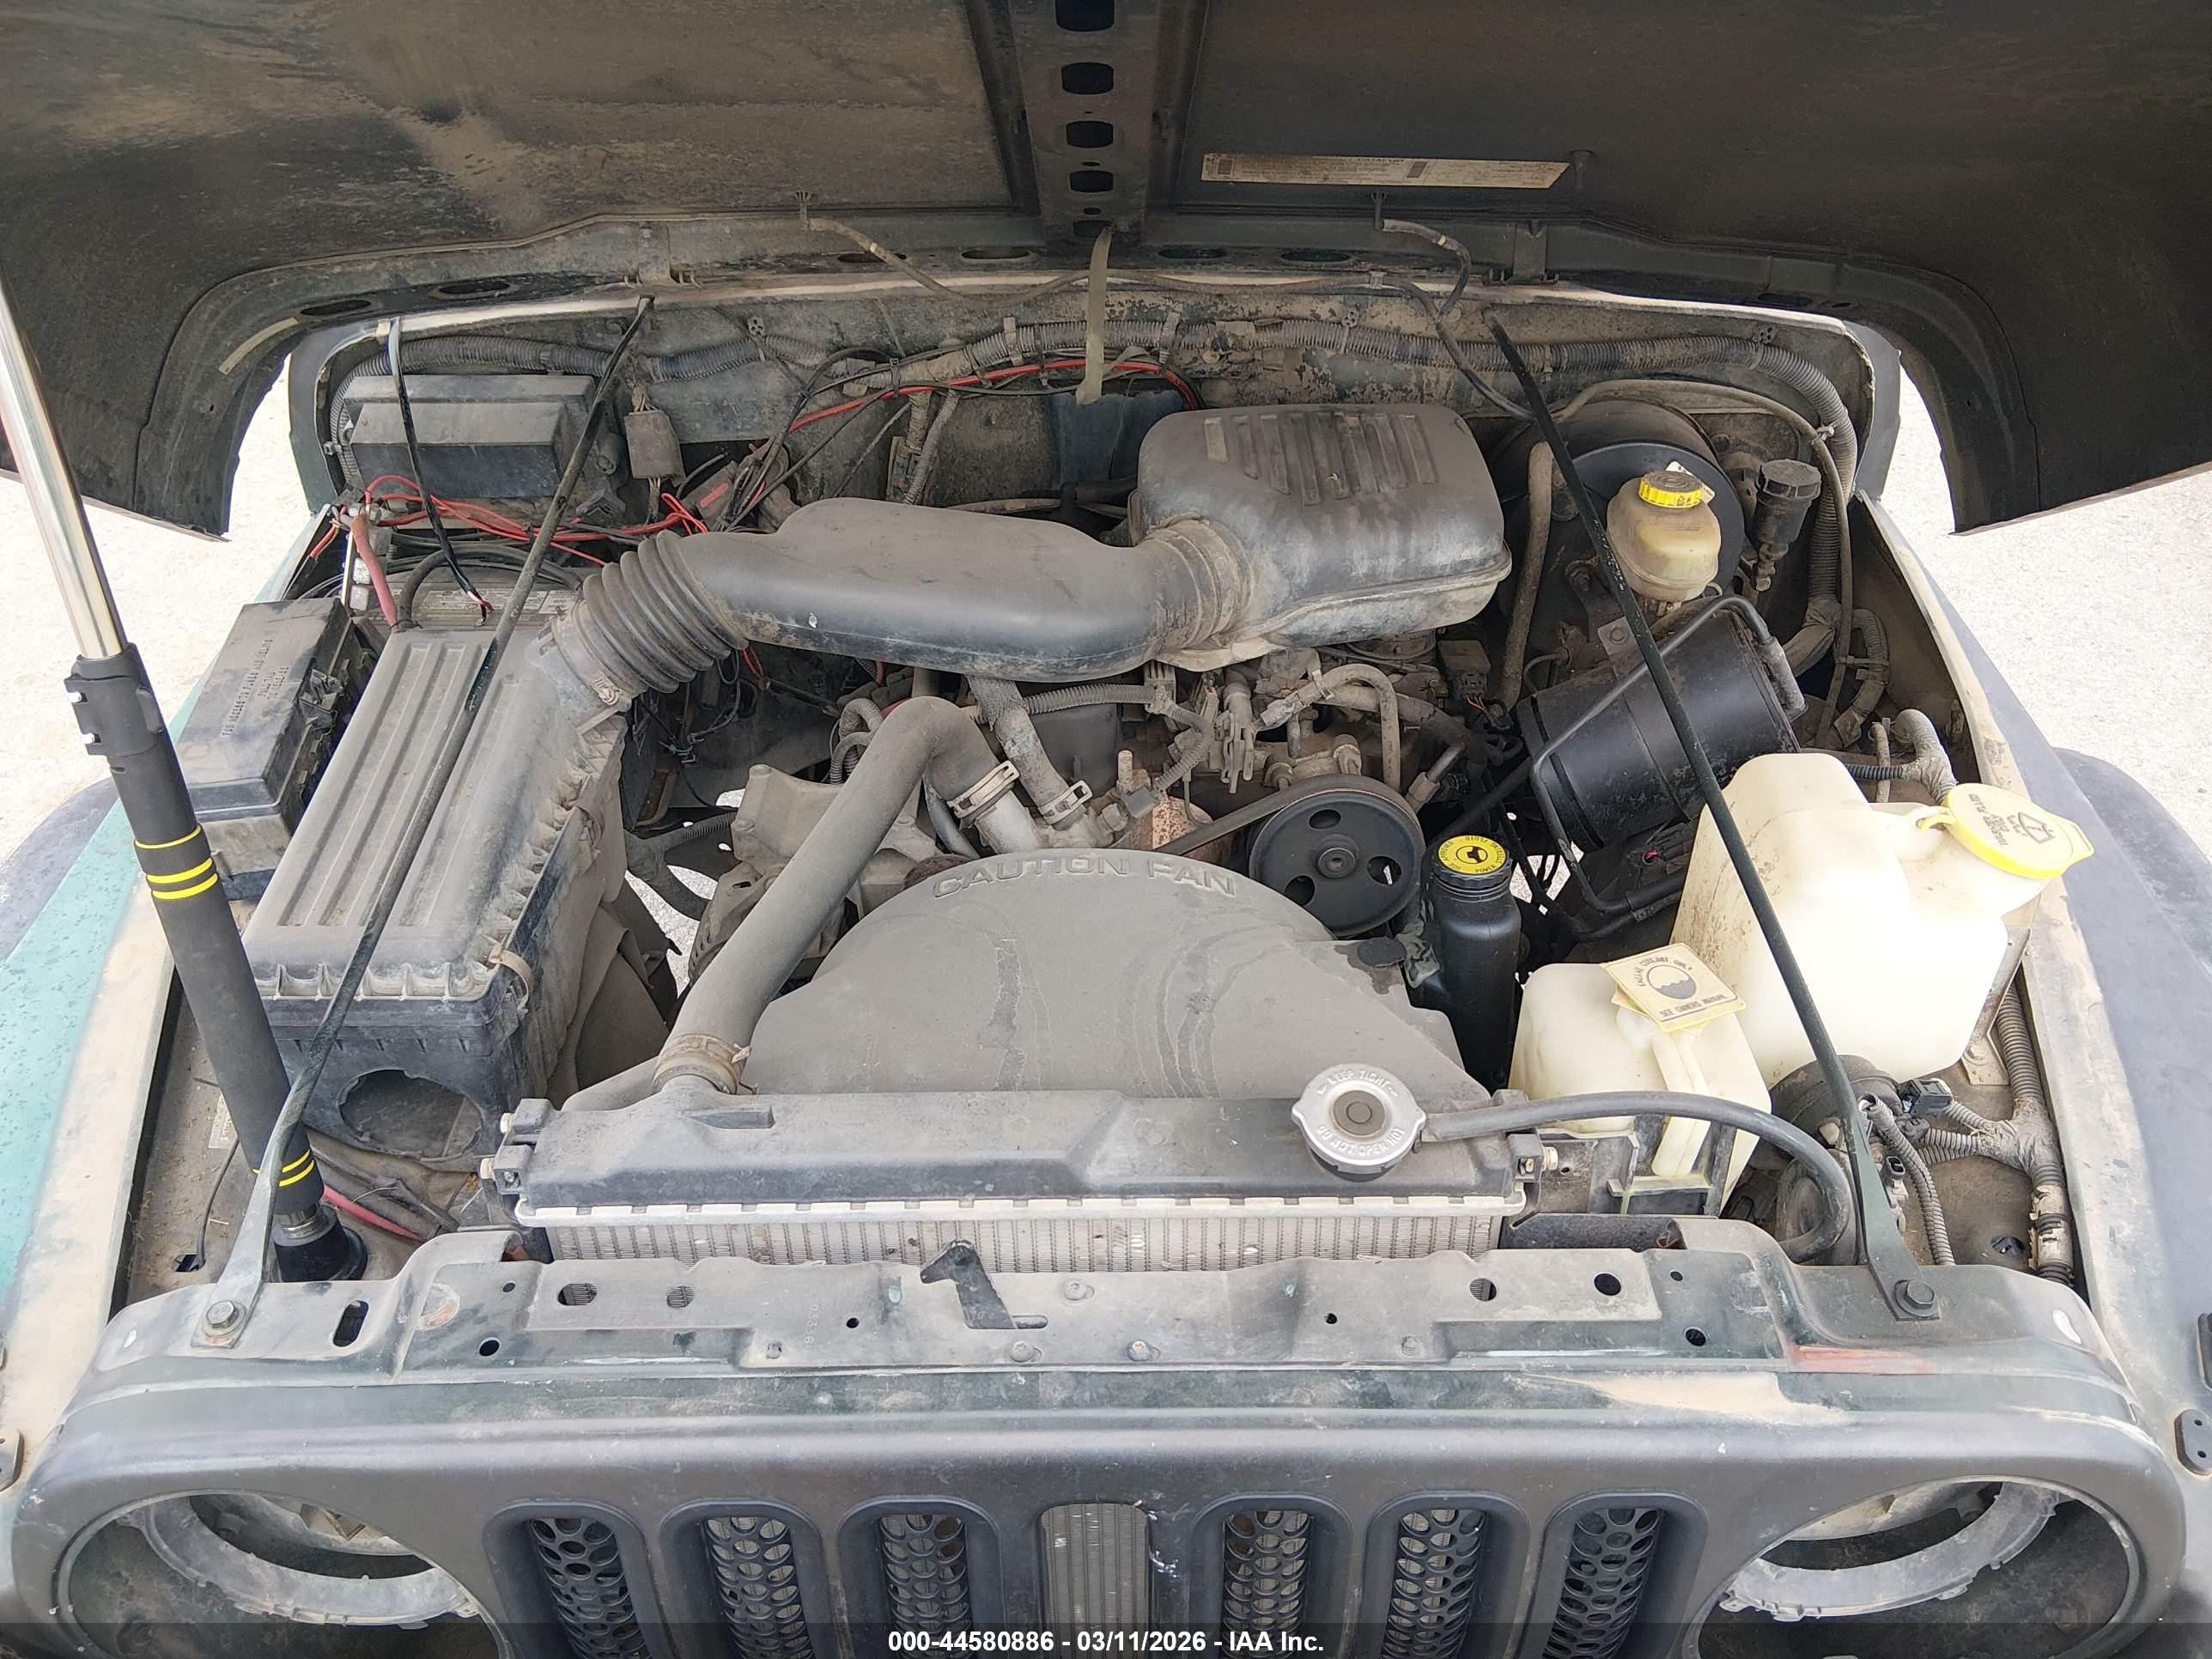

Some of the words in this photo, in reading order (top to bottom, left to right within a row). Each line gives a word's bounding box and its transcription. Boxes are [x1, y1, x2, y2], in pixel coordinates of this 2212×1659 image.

[1474, 864, 1498, 872] POWER
[933, 856, 1127, 898] CAUTION
[1147, 859, 1236, 898] FAN
[1640, 957, 1669, 967] COOLANT
[1674, 959, 1692, 971] ONLY
[1659, 1007, 1675, 1018] SEE
[1327, 1069, 1354, 1085] KEEP
[1358, 1069, 1390, 1088] TIGHT
[1316, 1126, 1332, 1141] DO
[1329, 1139, 1356, 1153] NOT
[1358, 1142, 1387, 1157] OPEN
